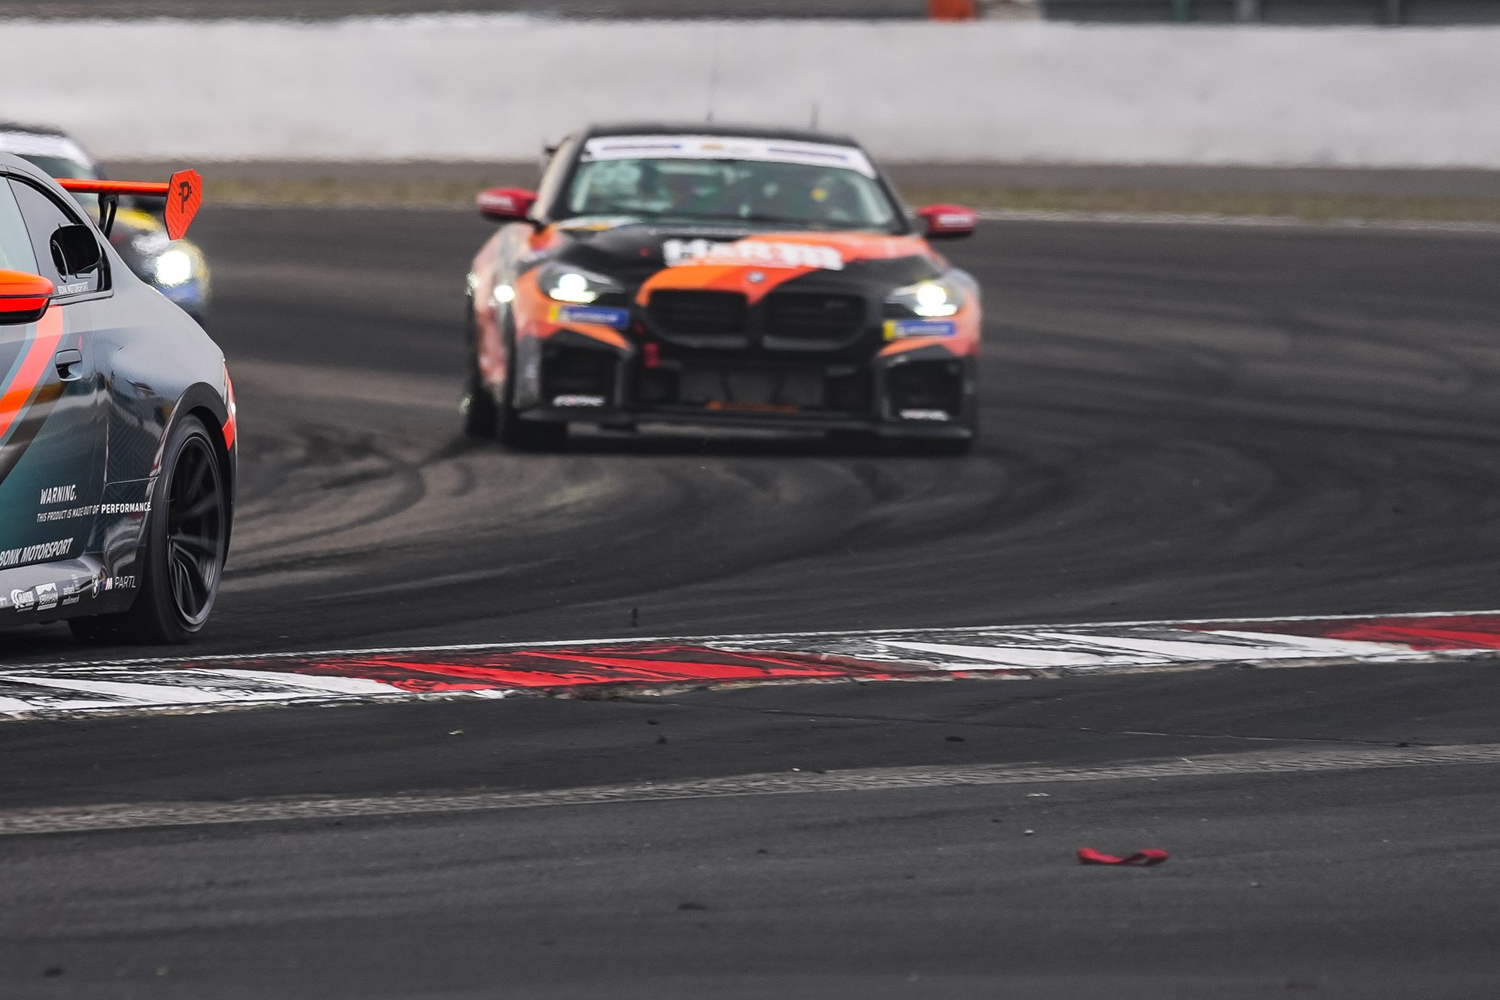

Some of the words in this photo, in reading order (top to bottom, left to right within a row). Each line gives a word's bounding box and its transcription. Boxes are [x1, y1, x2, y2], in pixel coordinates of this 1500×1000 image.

[40, 484, 77, 505] WARNING.
[36, 513, 46, 523] THIS
[46, 510, 67, 521] PRODUCT
[72, 508, 83, 518] MADE
[20, 537, 74, 563] MOTORSPORT
